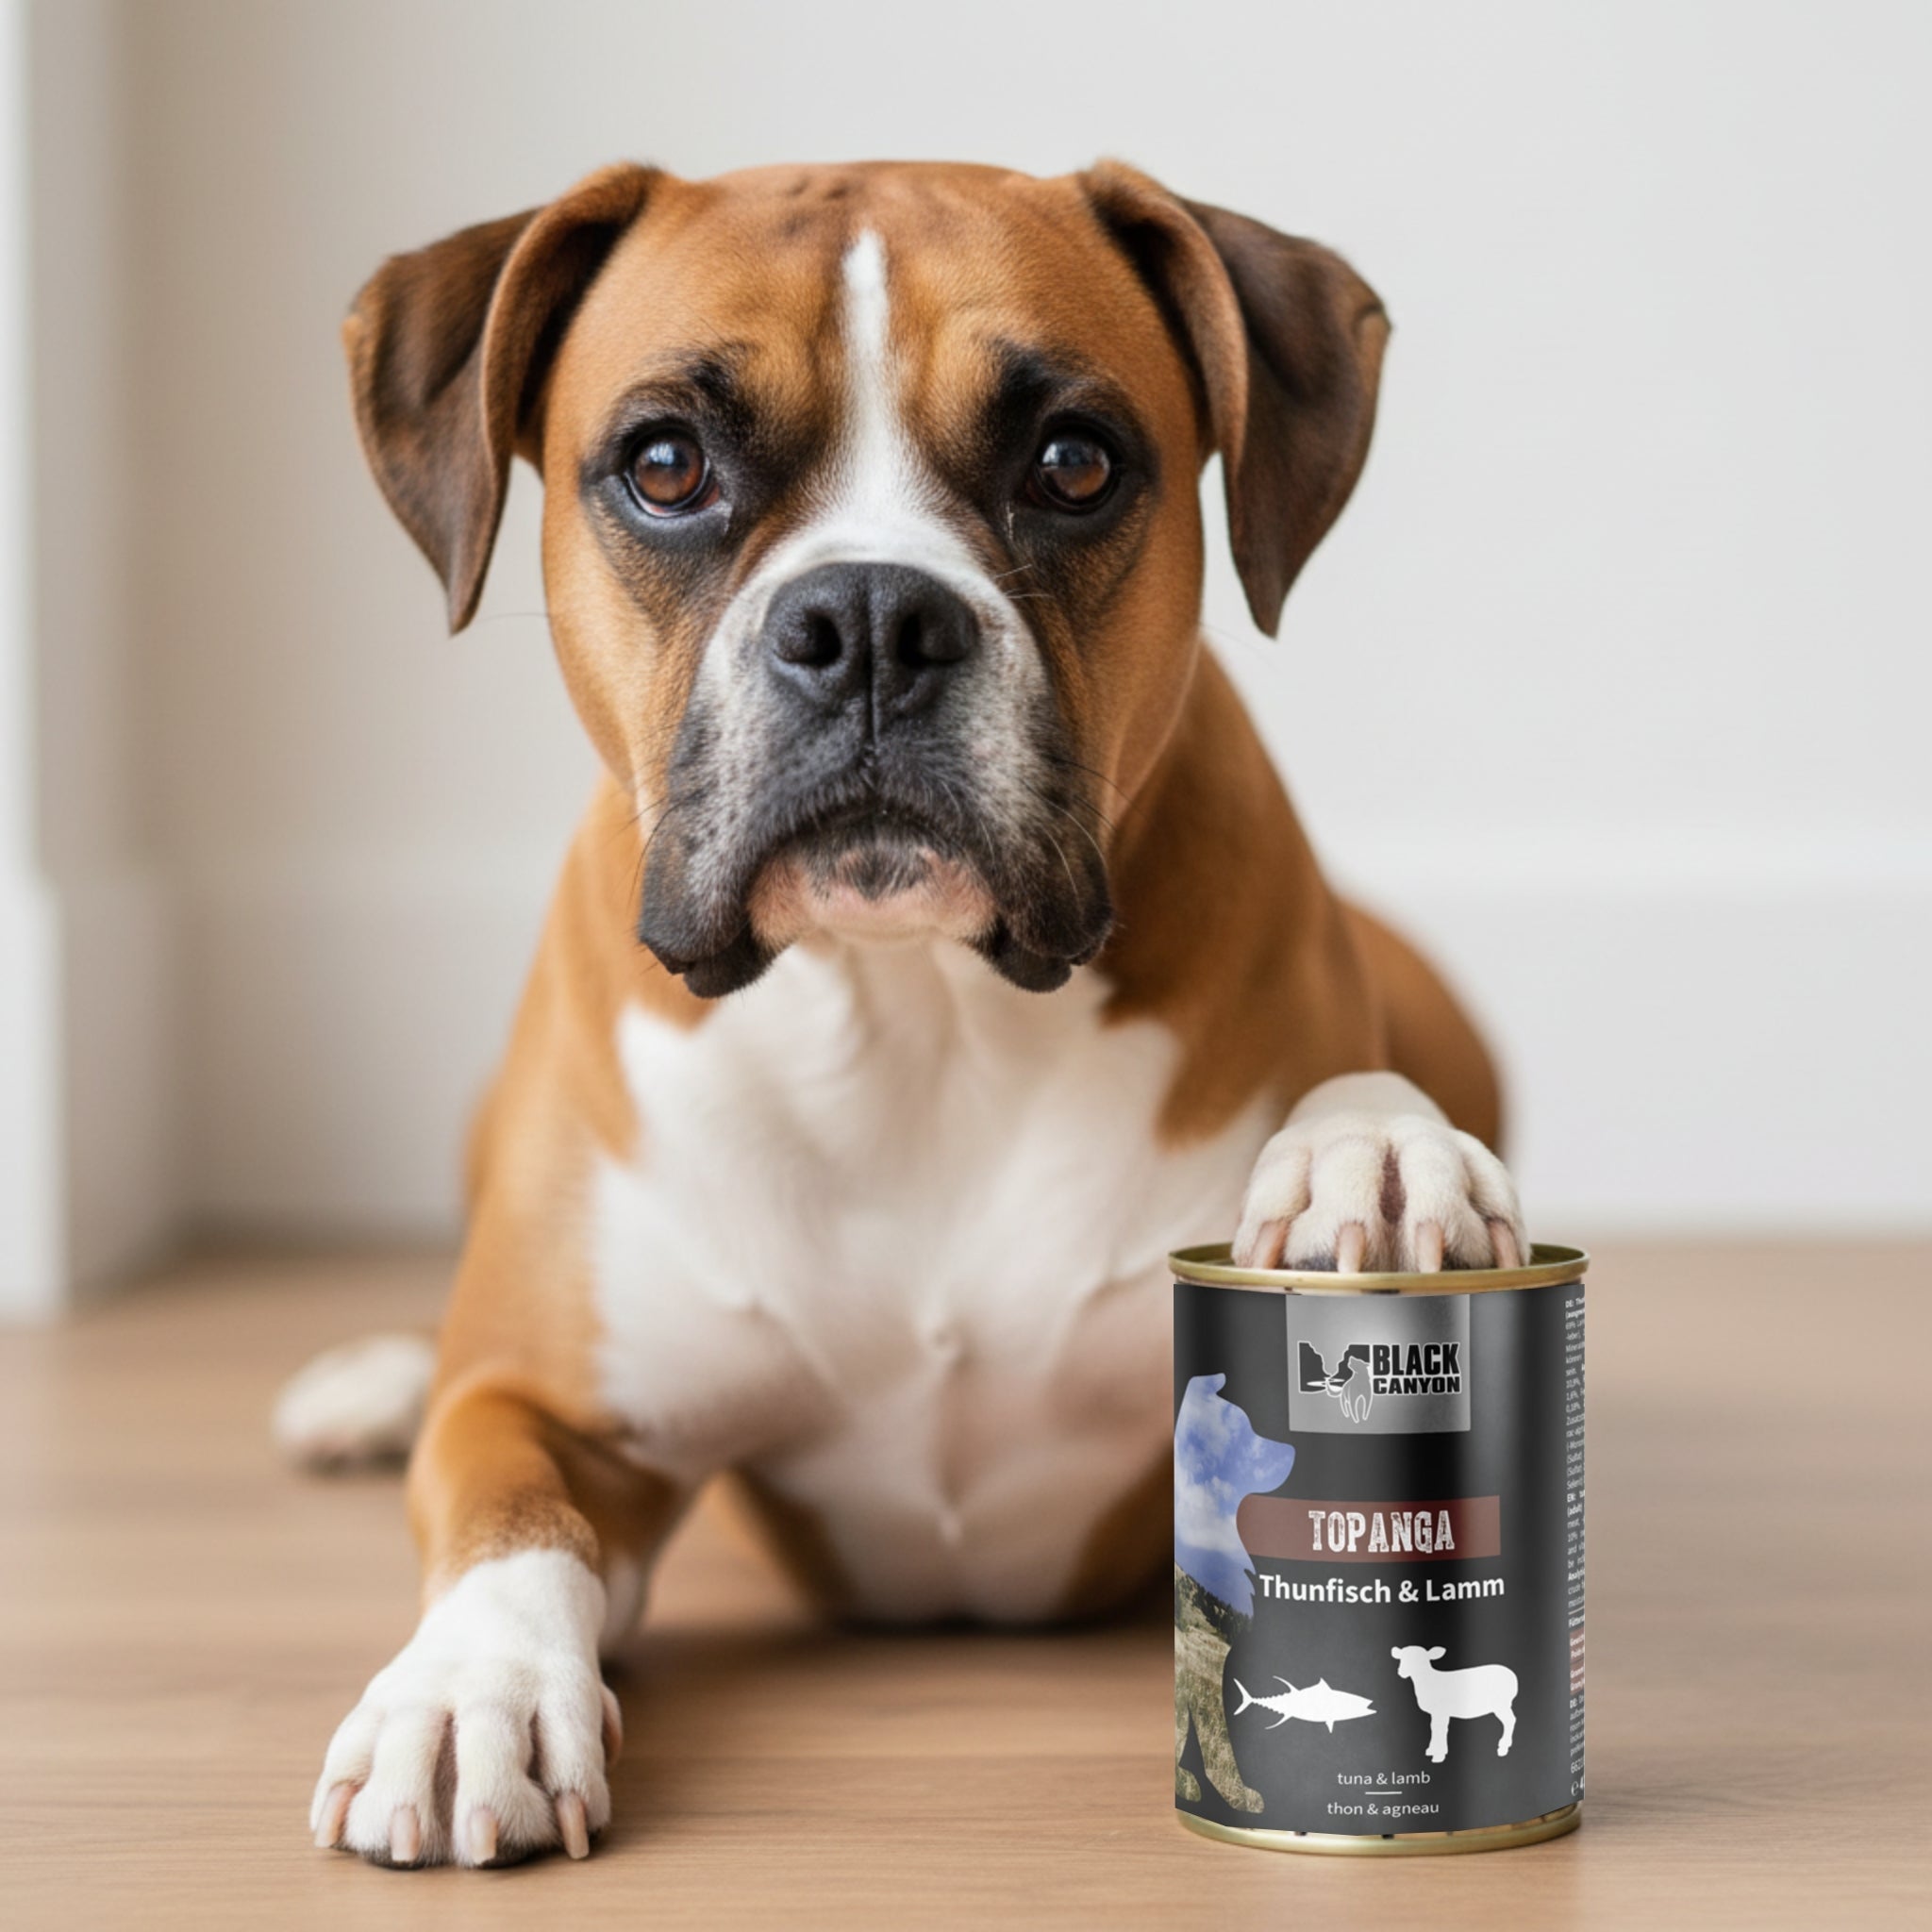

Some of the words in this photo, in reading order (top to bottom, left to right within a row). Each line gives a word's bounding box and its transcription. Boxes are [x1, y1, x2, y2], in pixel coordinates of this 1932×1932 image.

[1373, 1342, 1461, 1376] BLACK
[1373, 1376, 1461, 1395] CANYON
[1308, 1510, 1455, 1554] TOPANGA
[1259, 1574, 1391, 1604] Thunfisch
[1398, 1579, 1419, 1603] &
[1426, 1577, 1506, 1602] Lamm
[1337, 1772, 1373, 1786] tuna
[1375, 1772, 1389, 1786] &
[1391, 1770, 1431, 1785] lamb
[1326, 1801, 1364, 1816] thon
[1366, 1802, 1379, 1816] &
[1381, 1804, 1440, 1818] agneau
